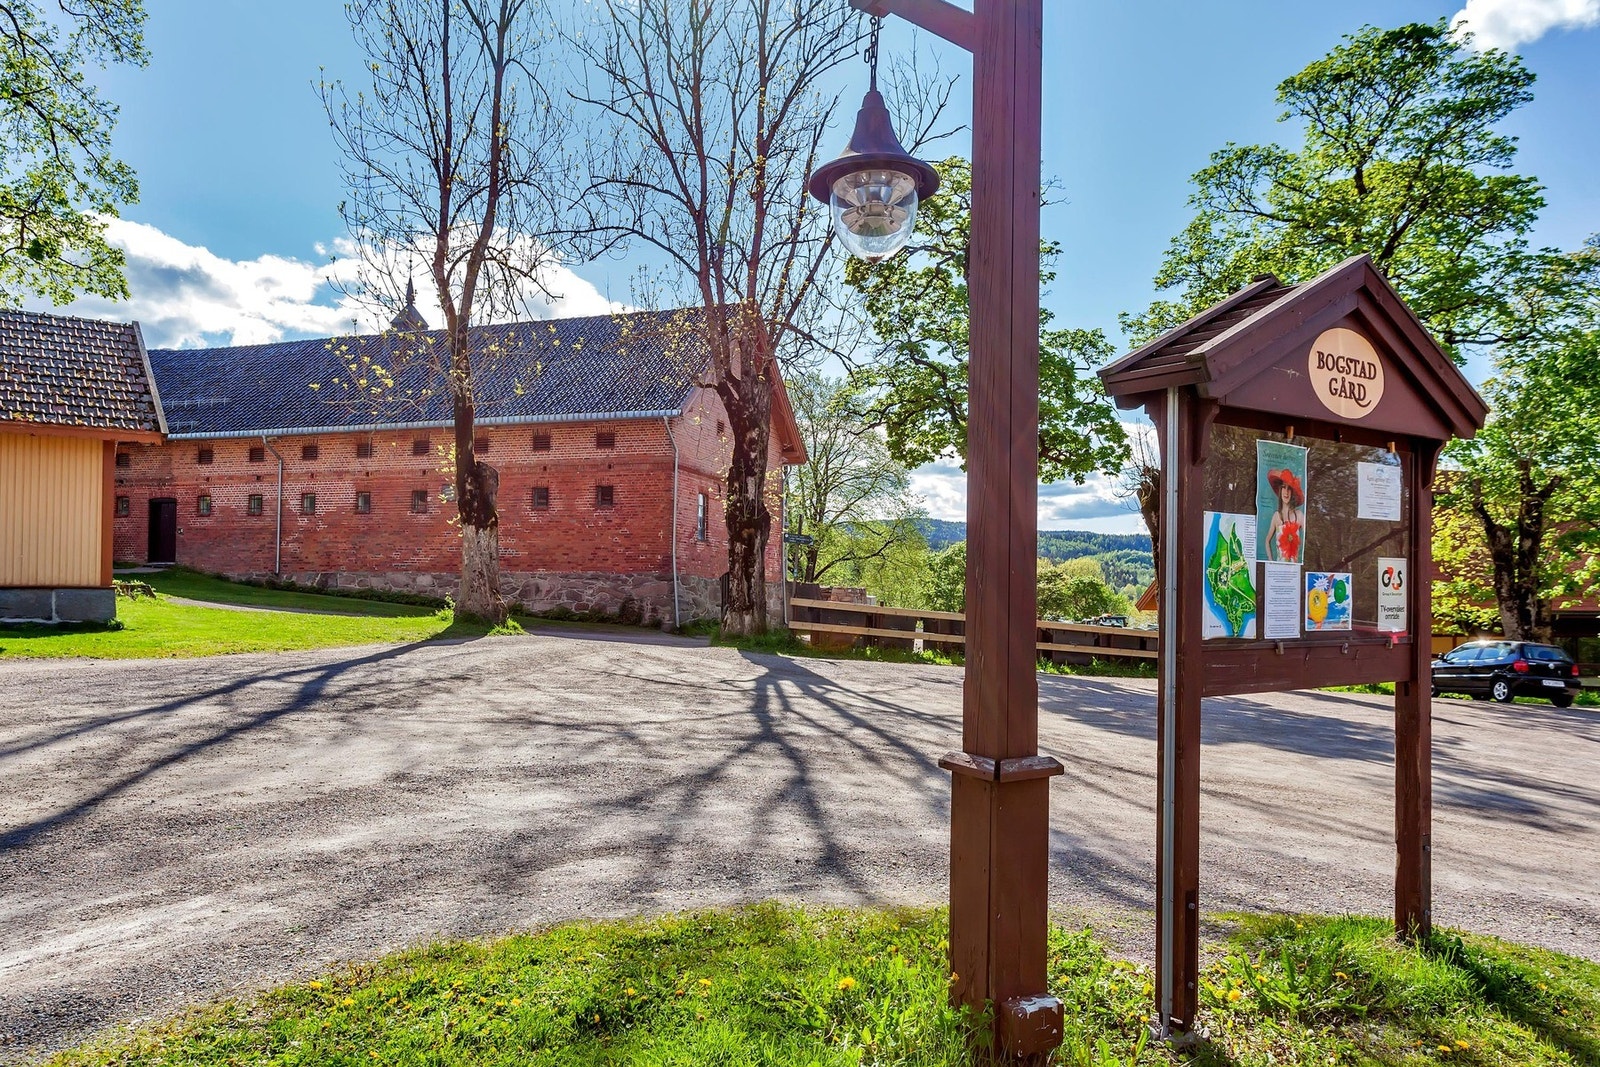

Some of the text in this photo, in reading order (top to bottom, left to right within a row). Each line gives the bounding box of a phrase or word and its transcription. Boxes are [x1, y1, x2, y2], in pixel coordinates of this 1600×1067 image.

[1316, 350, 1377, 380] BOGSTAD
[1328, 376, 1372, 408] GÅRD
[1381, 566, 1403, 591] G4S
